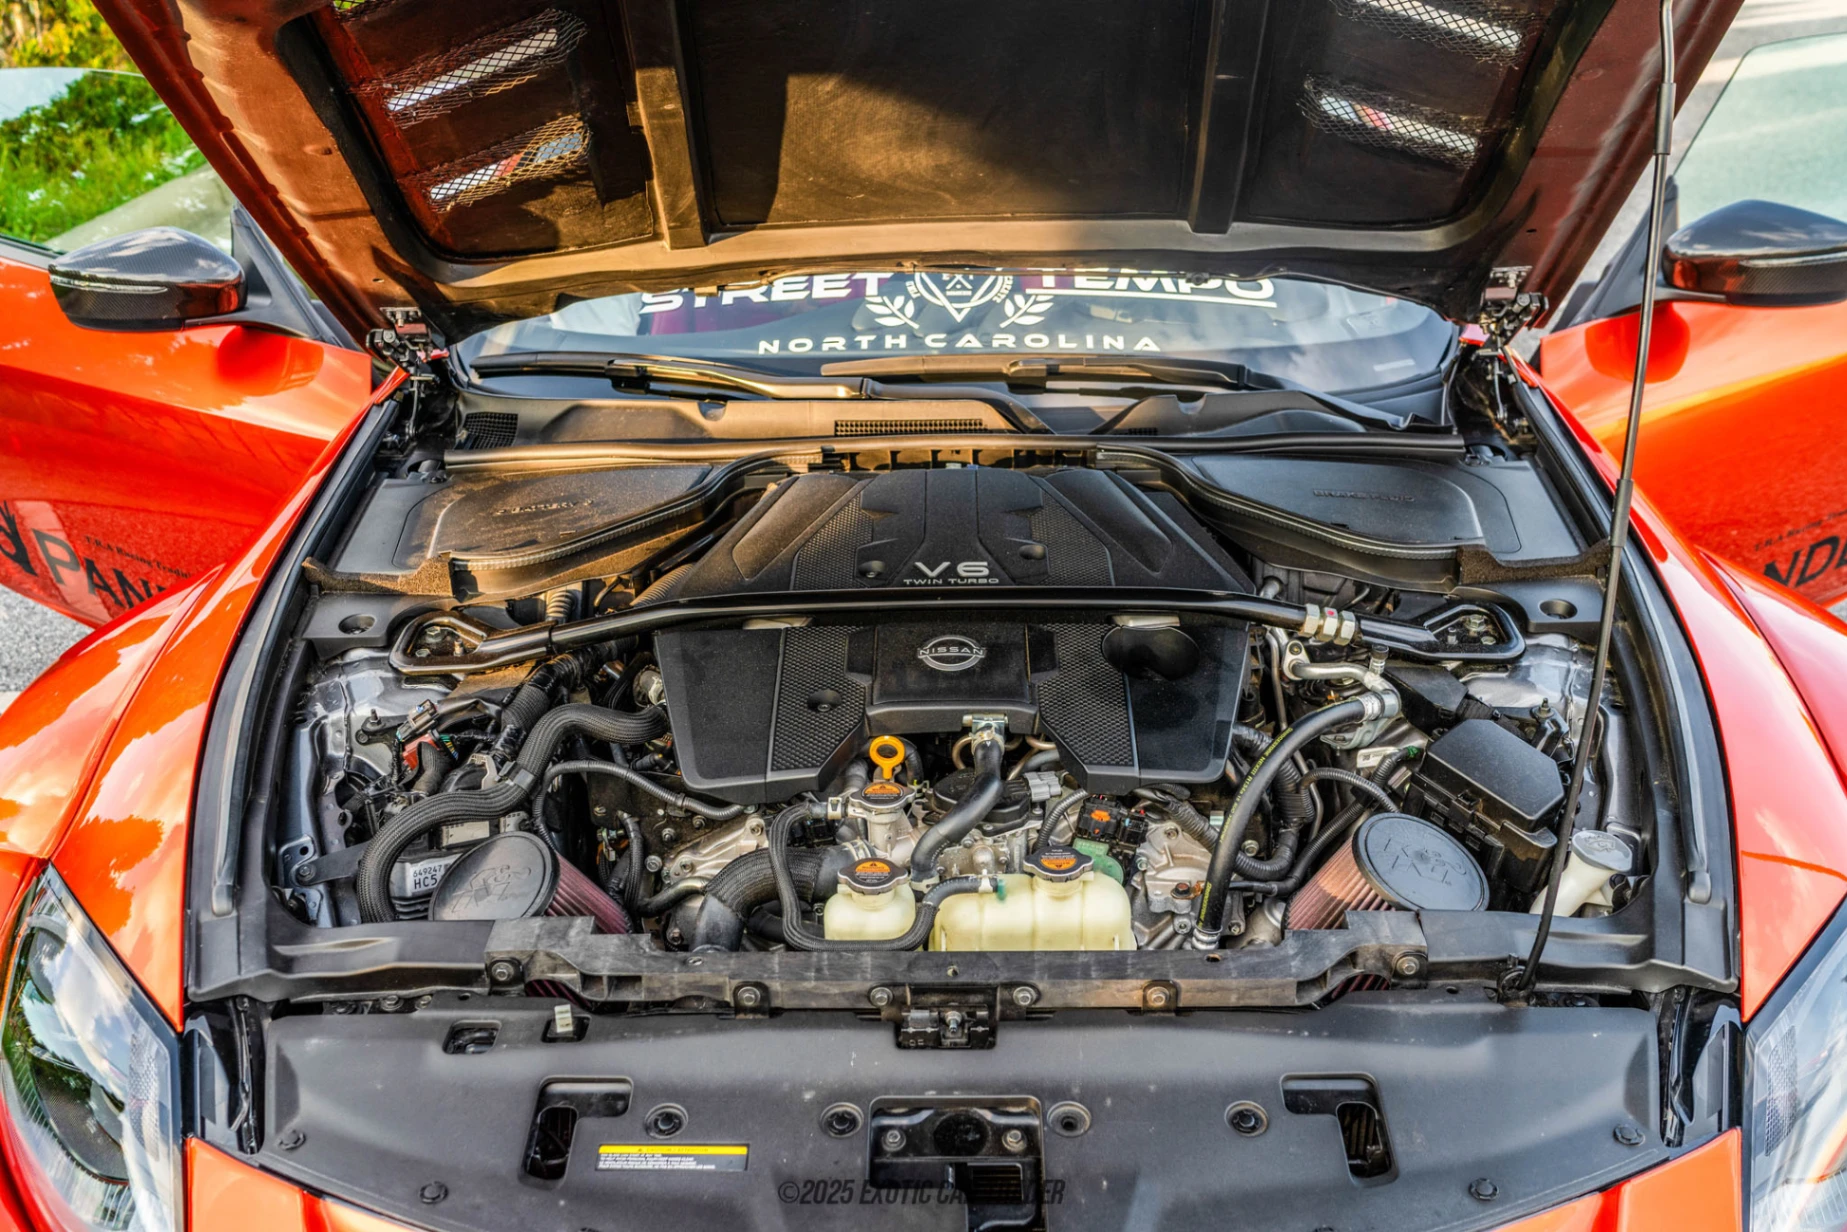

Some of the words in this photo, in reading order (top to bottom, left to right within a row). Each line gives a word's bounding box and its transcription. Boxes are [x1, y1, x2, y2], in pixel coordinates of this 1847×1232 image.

[758, 333, 907, 355] NORTH
[924, 332, 1161, 352] CAROLINA
[914, 561, 990, 578] V6
[903, 578, 943, 586] TWIN
[919, 646, 984, 656] NISSAN
